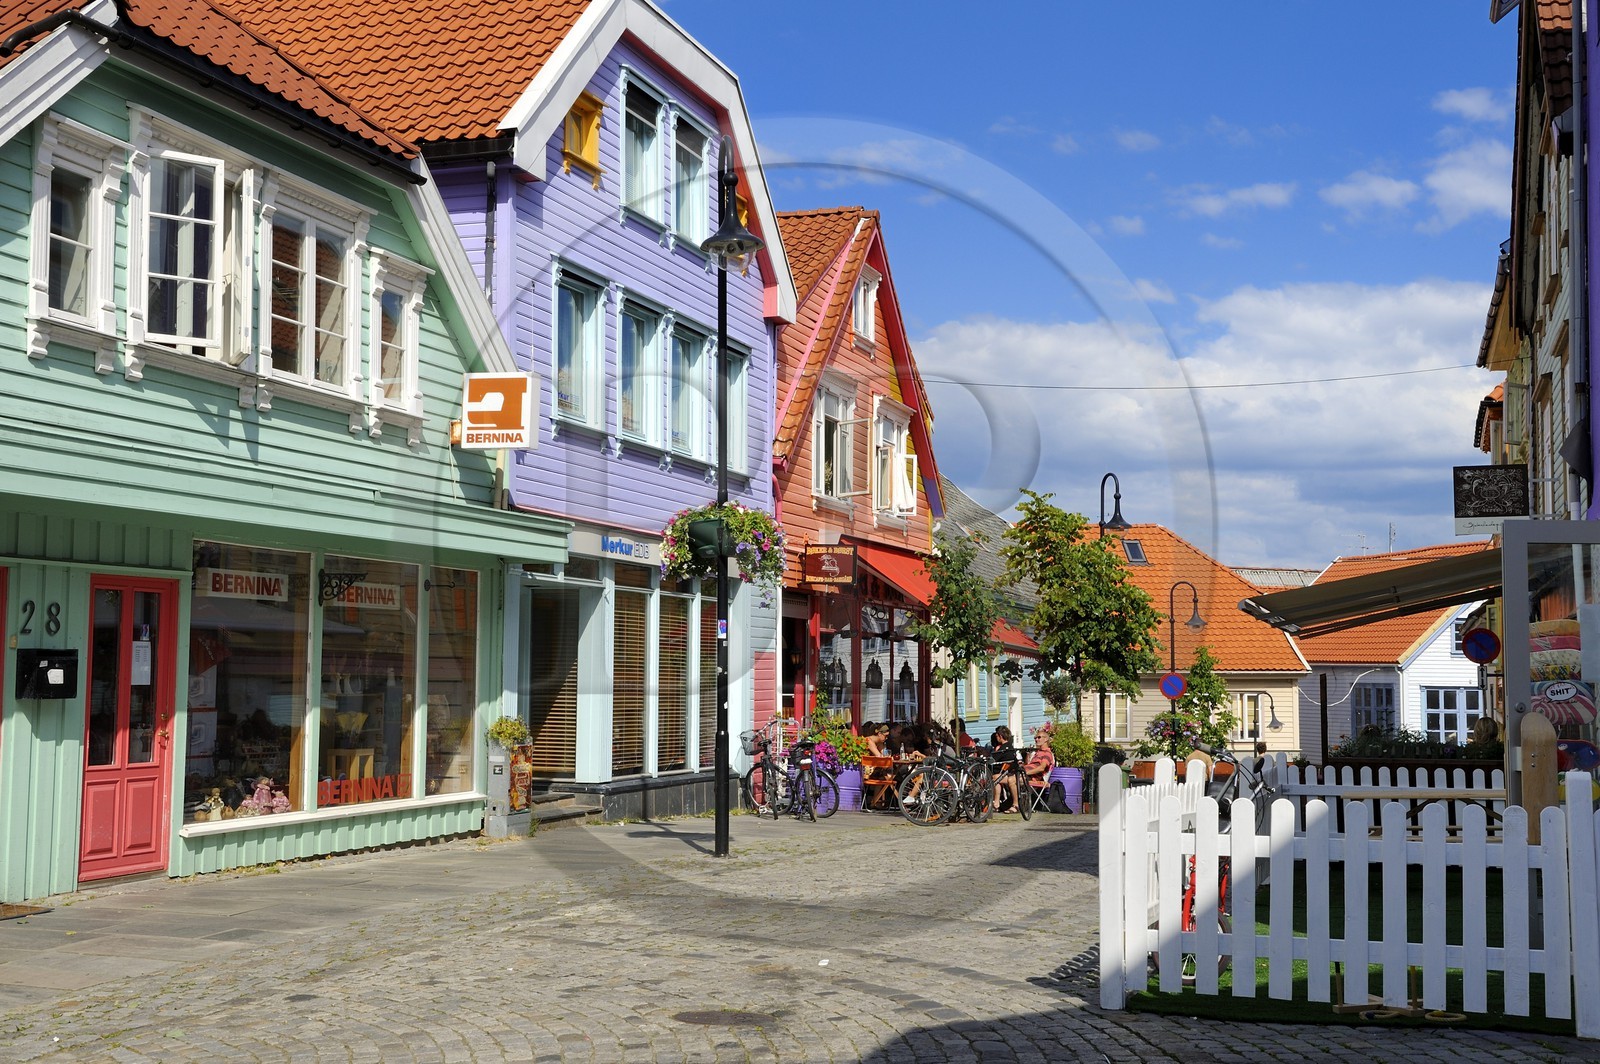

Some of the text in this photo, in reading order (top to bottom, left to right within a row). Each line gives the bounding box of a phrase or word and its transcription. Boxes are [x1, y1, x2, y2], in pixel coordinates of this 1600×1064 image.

[466, 433, 524, 444] BERNINA
[601, 536, 650, 559] Merkur EDB
[212, 573, 283, 597] BERNINA
[337, 585, 396, 606] BERNINA
[20, 600, 61, 637] 28
[1550, 687, 1570, 697] SHIT
[317, 775, 394, 806] BERNINA
